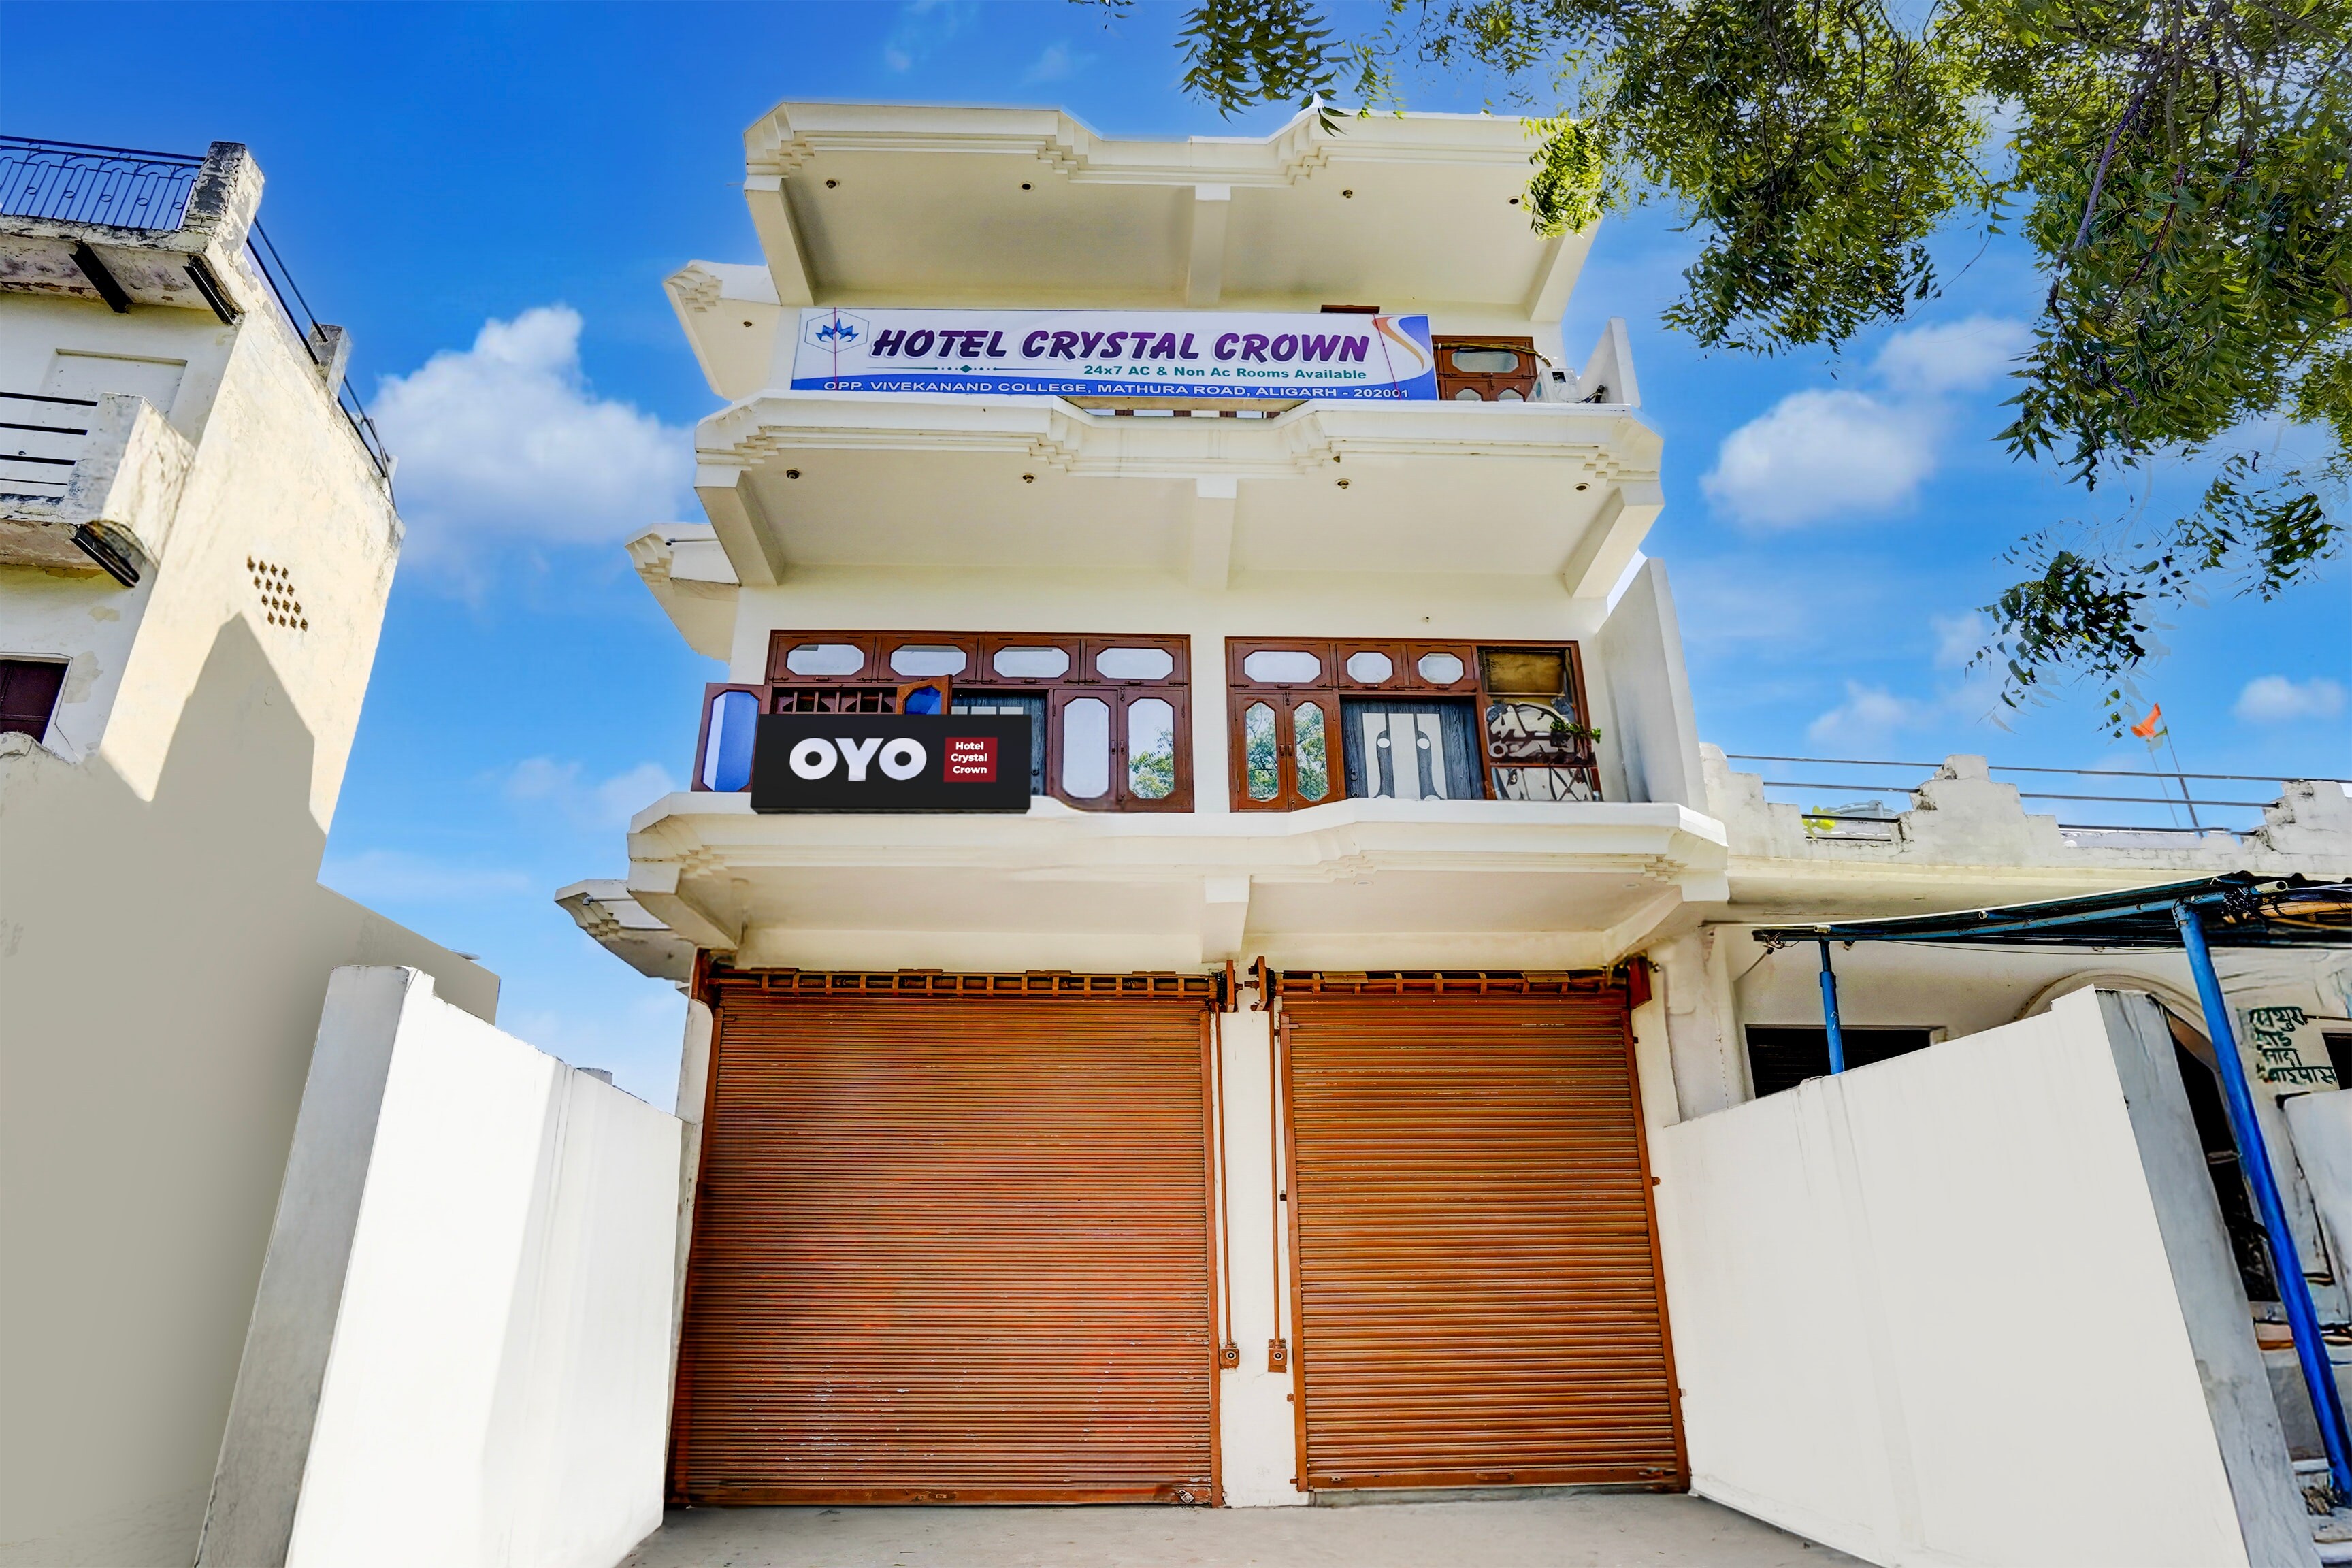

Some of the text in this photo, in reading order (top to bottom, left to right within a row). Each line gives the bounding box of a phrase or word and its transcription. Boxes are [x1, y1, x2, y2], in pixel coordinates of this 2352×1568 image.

[870, 329, 1370, 363] HOTEL CRYSTAL CROWN
[1083, 365, 1367, 380] 24x7 AC & Non Ac Rooms Available
[823, 381, 864, 391] OPP.
[870, 381, 992, 393] VIVEKANAND
[997, 382, 1091, 394] COLLEGE,
[1097, 383, 1190, 395] MATHURA
[1193, 385, 1251, 397] ROAD,
[1254, 386, 1337, 397] ALIGARH
[1353, 388, 1409, 398] 202001
[956, 741, 984, 751] Hotel
[789, 737, 927, 781] OYO
[950, 753, 987, 764] Crystal
[952, 765, 987, 774] Crown
